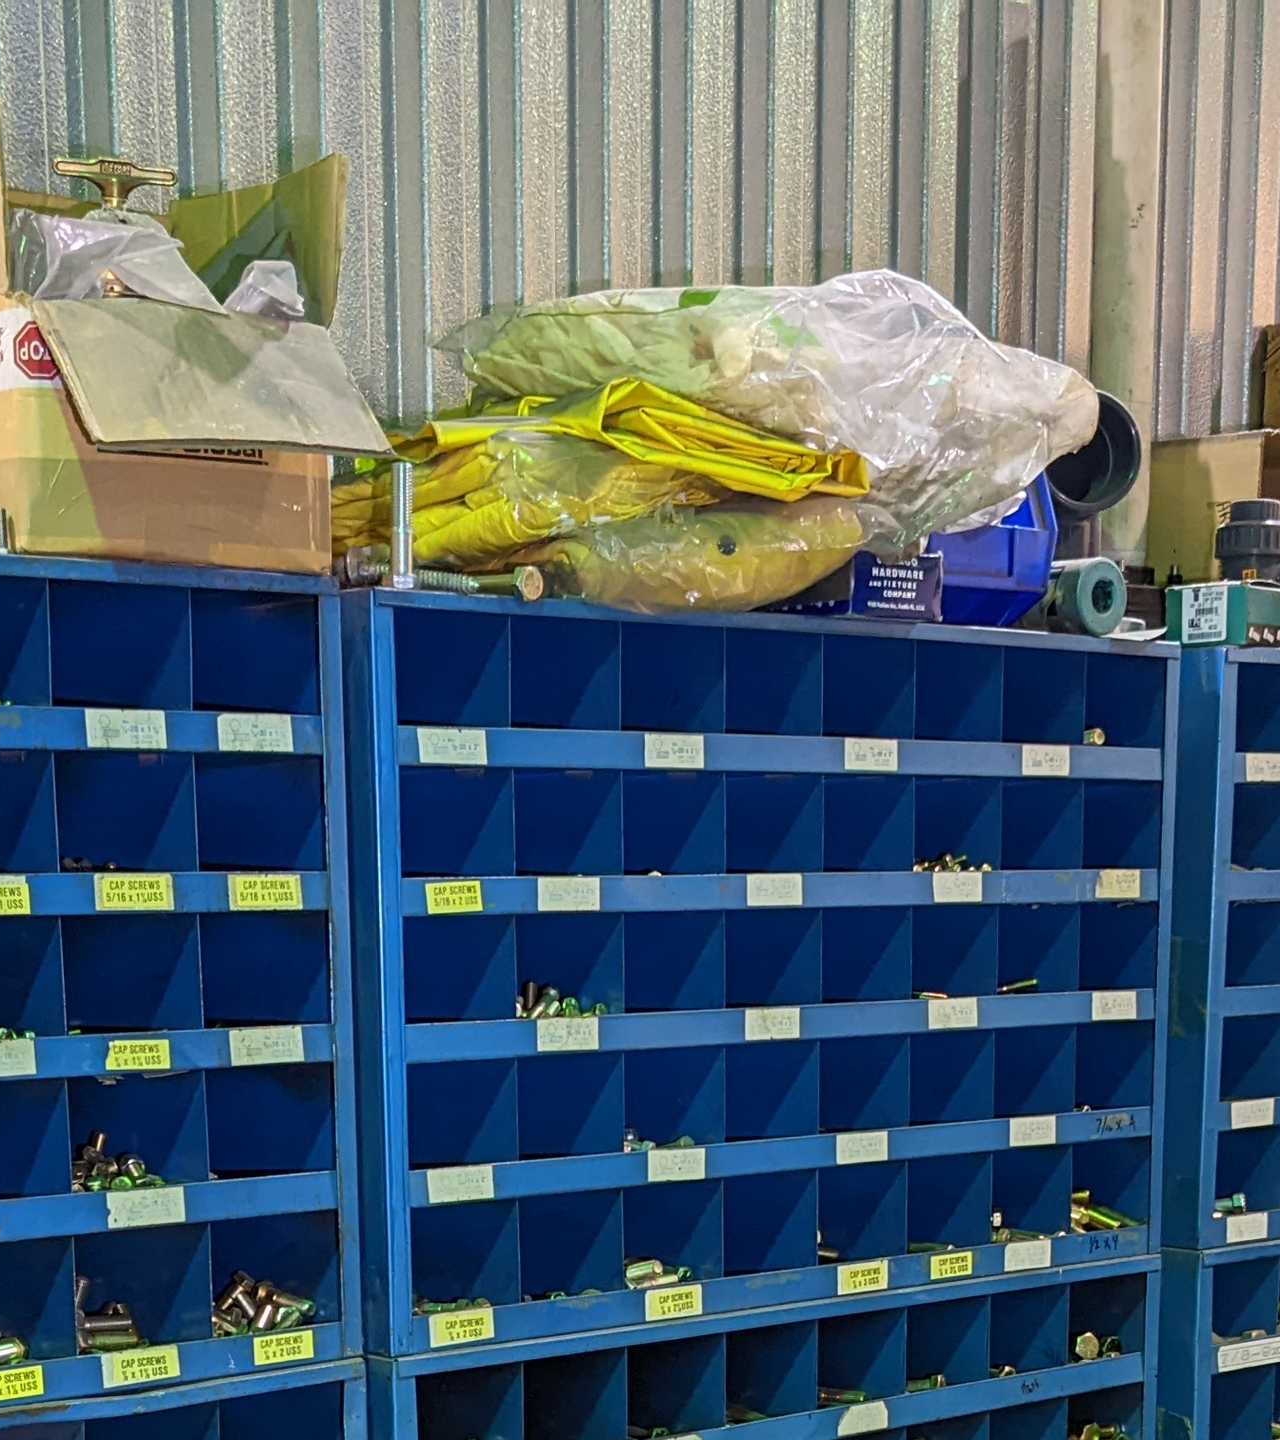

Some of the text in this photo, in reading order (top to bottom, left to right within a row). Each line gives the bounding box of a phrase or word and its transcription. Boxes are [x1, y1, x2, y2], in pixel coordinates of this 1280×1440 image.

[871, 566, 924, 580] HARDWARE
[883, 579, 917, 590] FIXTURE
[882, 589, 917, 599] COMPANY
[109, 879, 161, 891] CAP SCREWS
[242, 880, 291, 890] CAP SCREWS
[433, 884, 477, 896] CAP SCREWS
[106, 892, 126, 903] 5/16
[147, 892, 164, 902] USS
[277, 891, 294, 901] USS
[465, 896, 478, 906] USS
[6, 899, 24, 910] USS
[113, 1044, 160, 1055] CAP SCREWS
[144, 1055, 161, 1065] USS
[849, 1267, 881, 1280] CAP SCREWS
[658, 1291, 693, 1305] CAP SCREWS
[445, 1317, 485, 1330] CAP SCREWS
[468, 1328, 483, 1338] USS
[260, 1335, 303, 1348] CAP SCREWS
[286, 1346, 301, 1355] USS
[121, 1355, 167, 1369] CAP SCREWS
[152, 1365, 169, 1376] USS
[4, 1370, 36, 1383] SCREWS
[20, 1380, 38, 1392] USS
